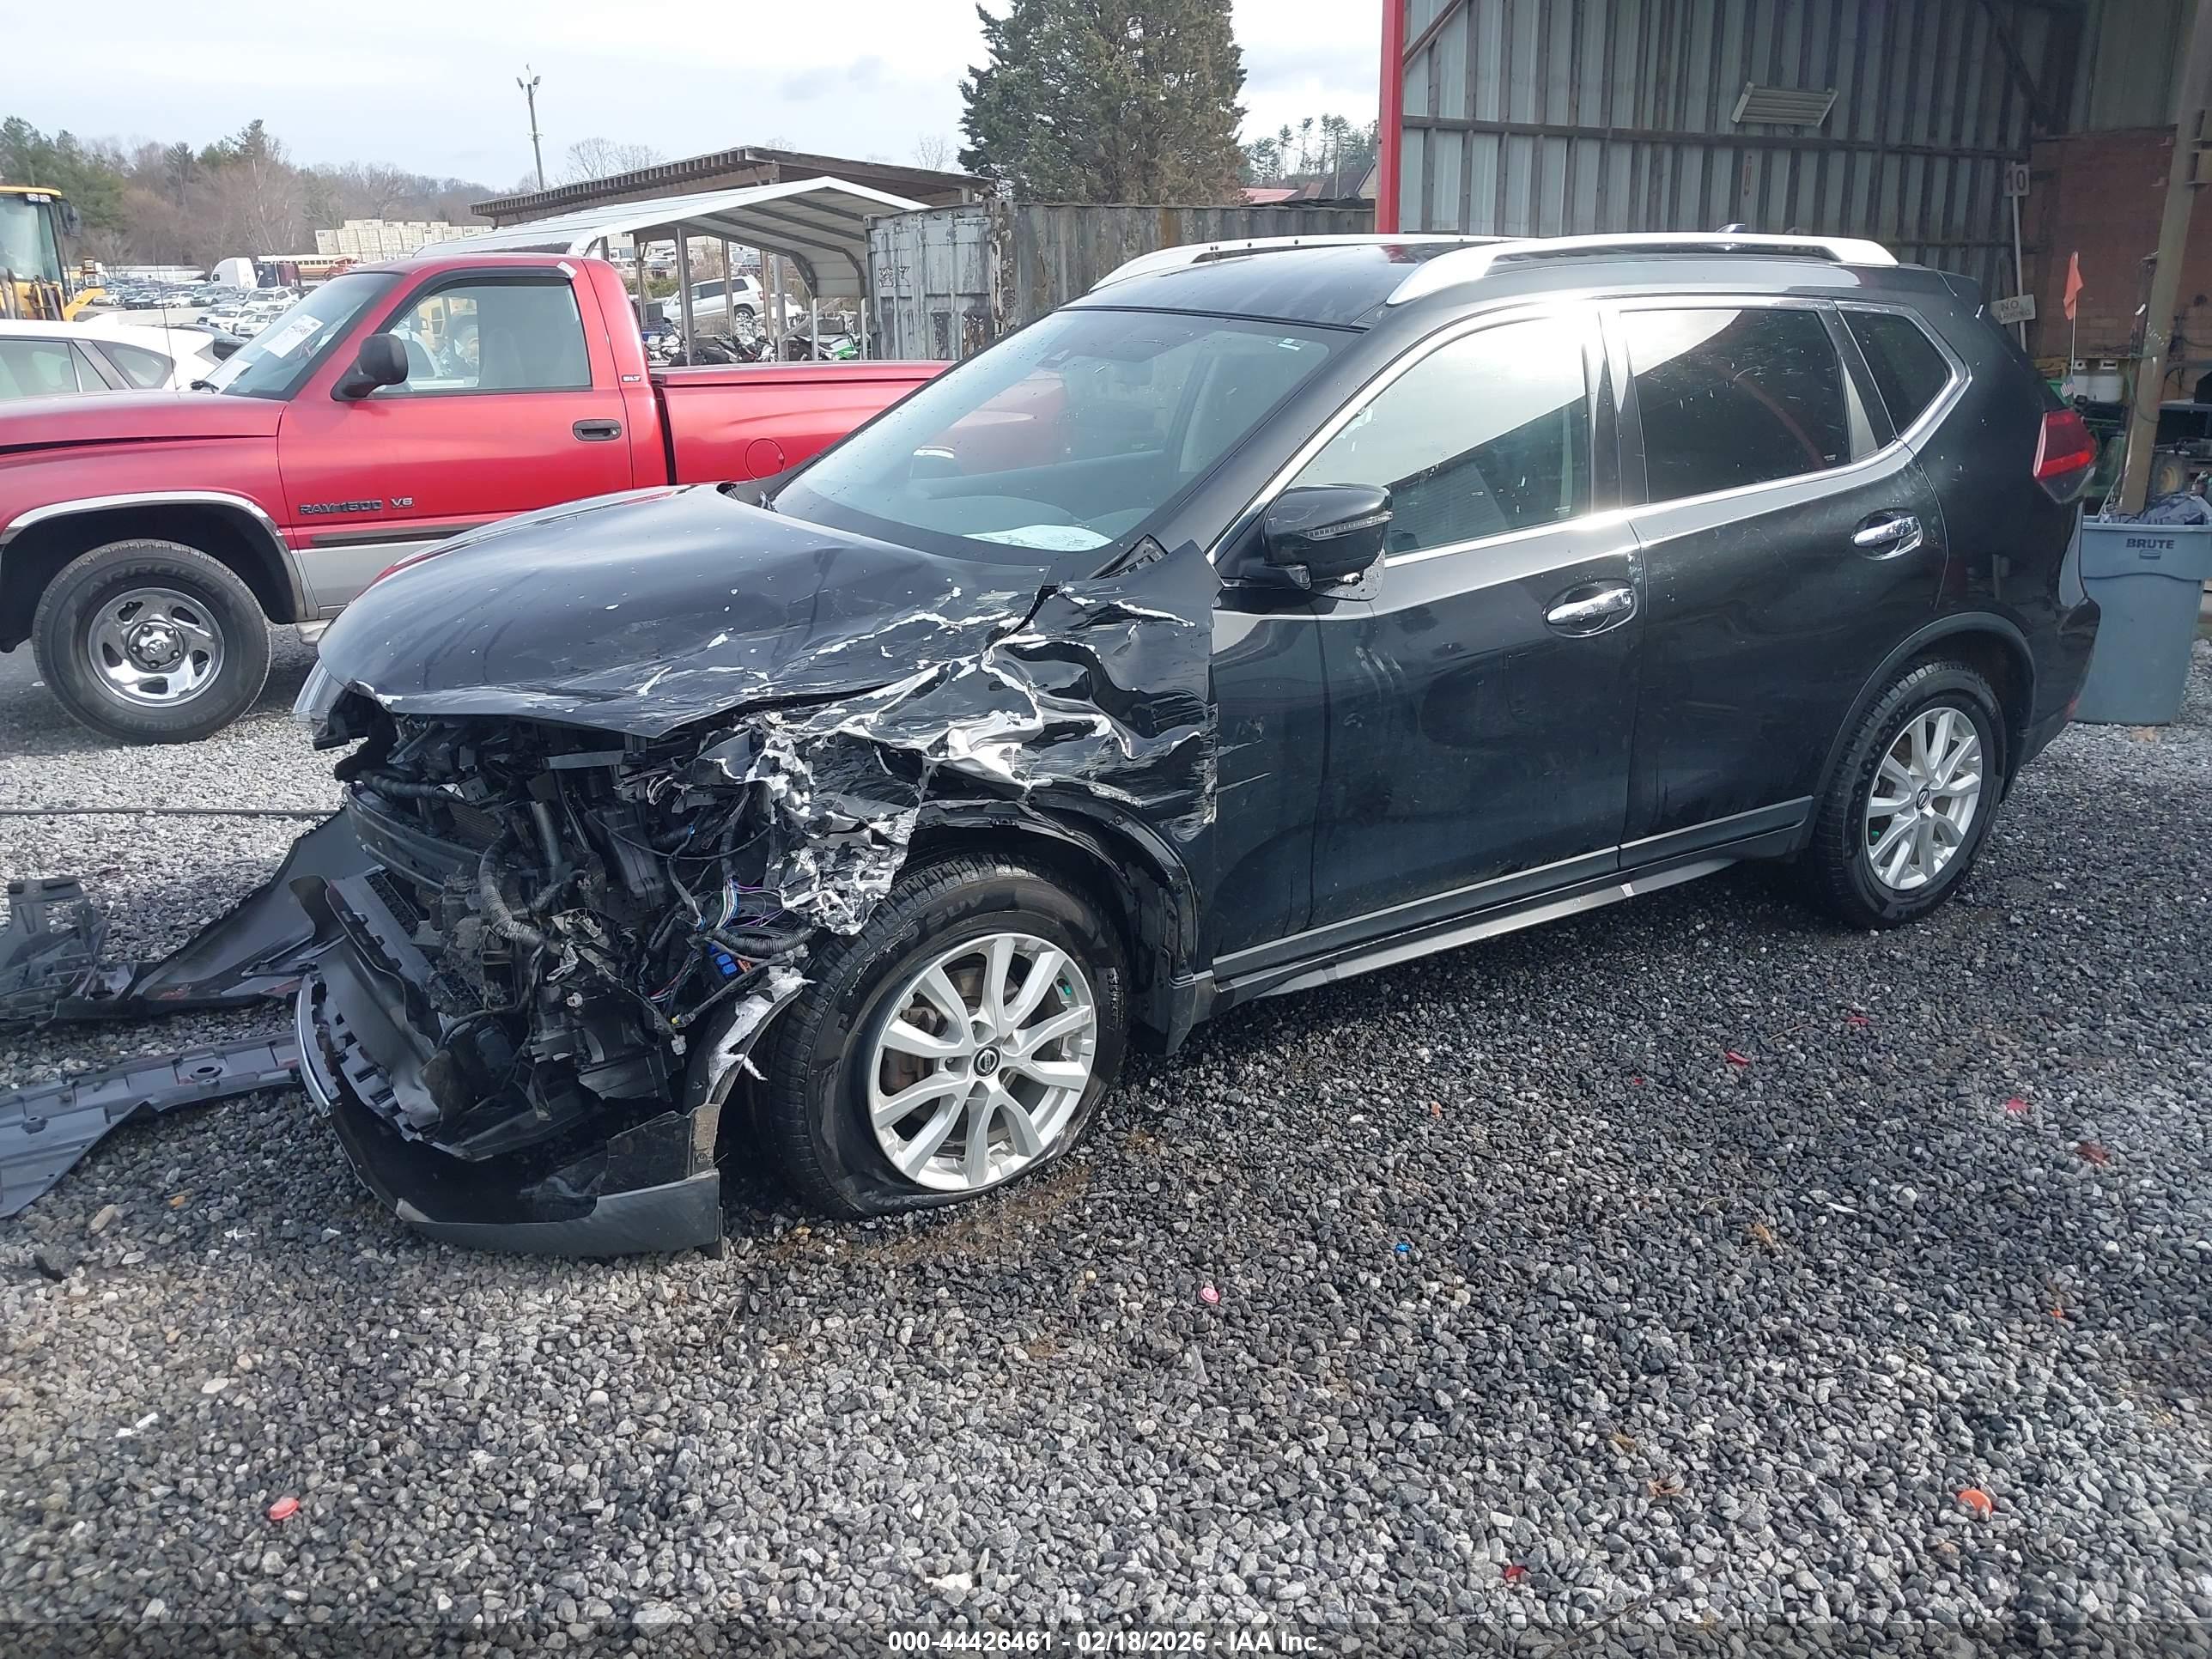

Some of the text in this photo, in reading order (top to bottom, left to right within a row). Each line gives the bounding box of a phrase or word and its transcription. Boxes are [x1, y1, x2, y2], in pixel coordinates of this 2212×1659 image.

[2005, 169, 2027, 191] 10
[2001, 301, 2019, 312] NO
[2126, 538, 2175, 550] BRUTE
